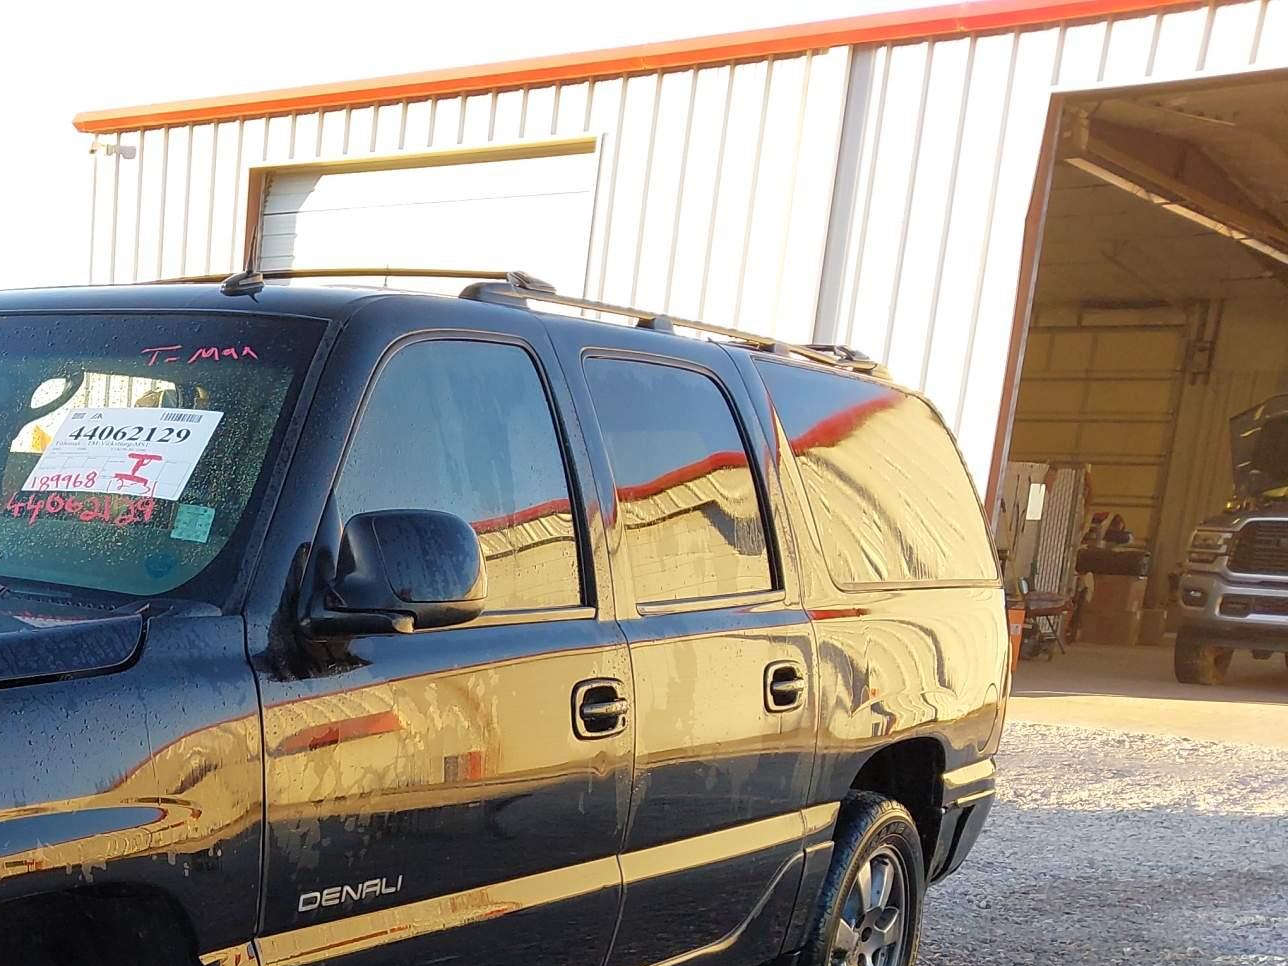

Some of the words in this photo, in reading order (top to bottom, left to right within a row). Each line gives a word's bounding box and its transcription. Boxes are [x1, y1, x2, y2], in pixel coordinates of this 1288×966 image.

[68, 425, 192, 444] 44062129
[30, 471, 98, 492] 189968
[298, 874, 403, 912] DENALI
